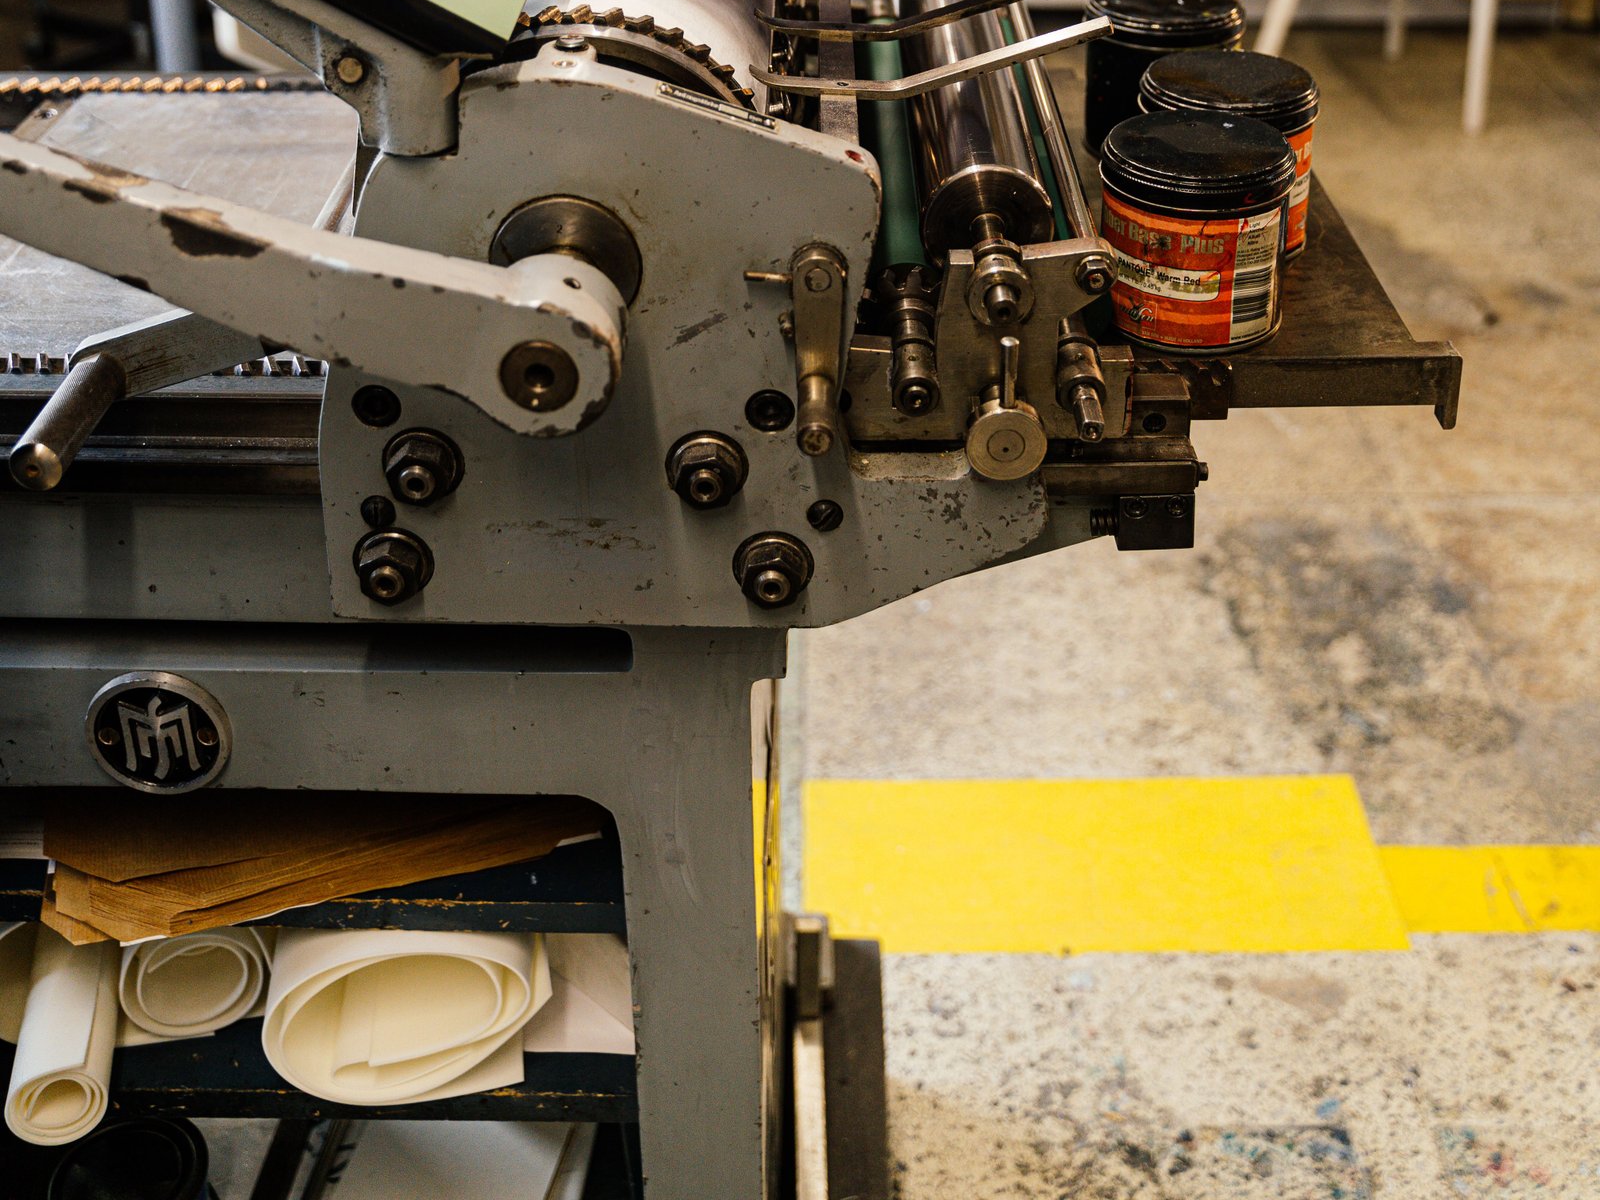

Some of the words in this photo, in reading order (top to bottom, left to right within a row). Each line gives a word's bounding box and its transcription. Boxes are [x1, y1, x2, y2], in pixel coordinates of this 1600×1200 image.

[556, 224, 563, 234] 2
[1128, 221, 1171, 250] Base
[1180, 234, 1225, 255] Plus
[1157, 271, 1181, 284] Warm
[1183, 276, 1202, 286] Red
